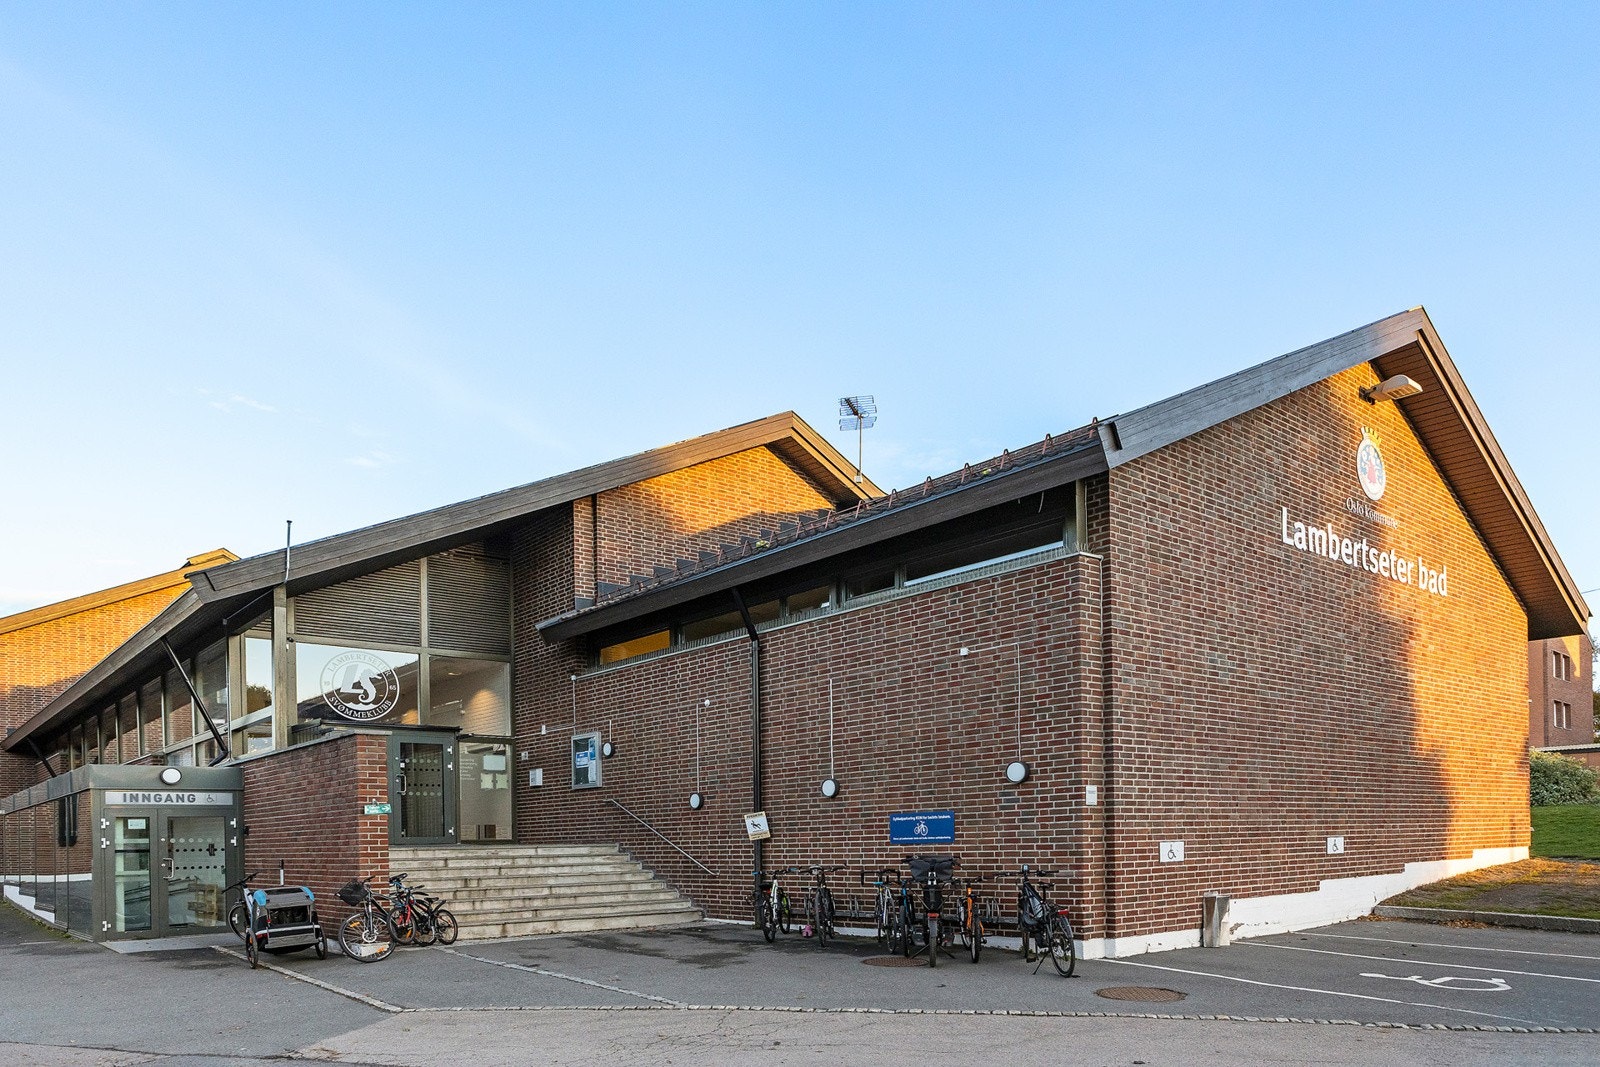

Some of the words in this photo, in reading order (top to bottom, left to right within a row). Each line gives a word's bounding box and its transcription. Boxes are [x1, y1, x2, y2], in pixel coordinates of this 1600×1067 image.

[1346, 497, 1364, 515] Oslo
[1281, 506, 1415, 585] Lambertseter
[1418, 556, 1448, 597] bad
[327, 653, 392, 677] LAMBERTSETER
[329, 696, 392, 718] SVØMMEKLUBB
[123, 793, 197, 803] INNGANG
